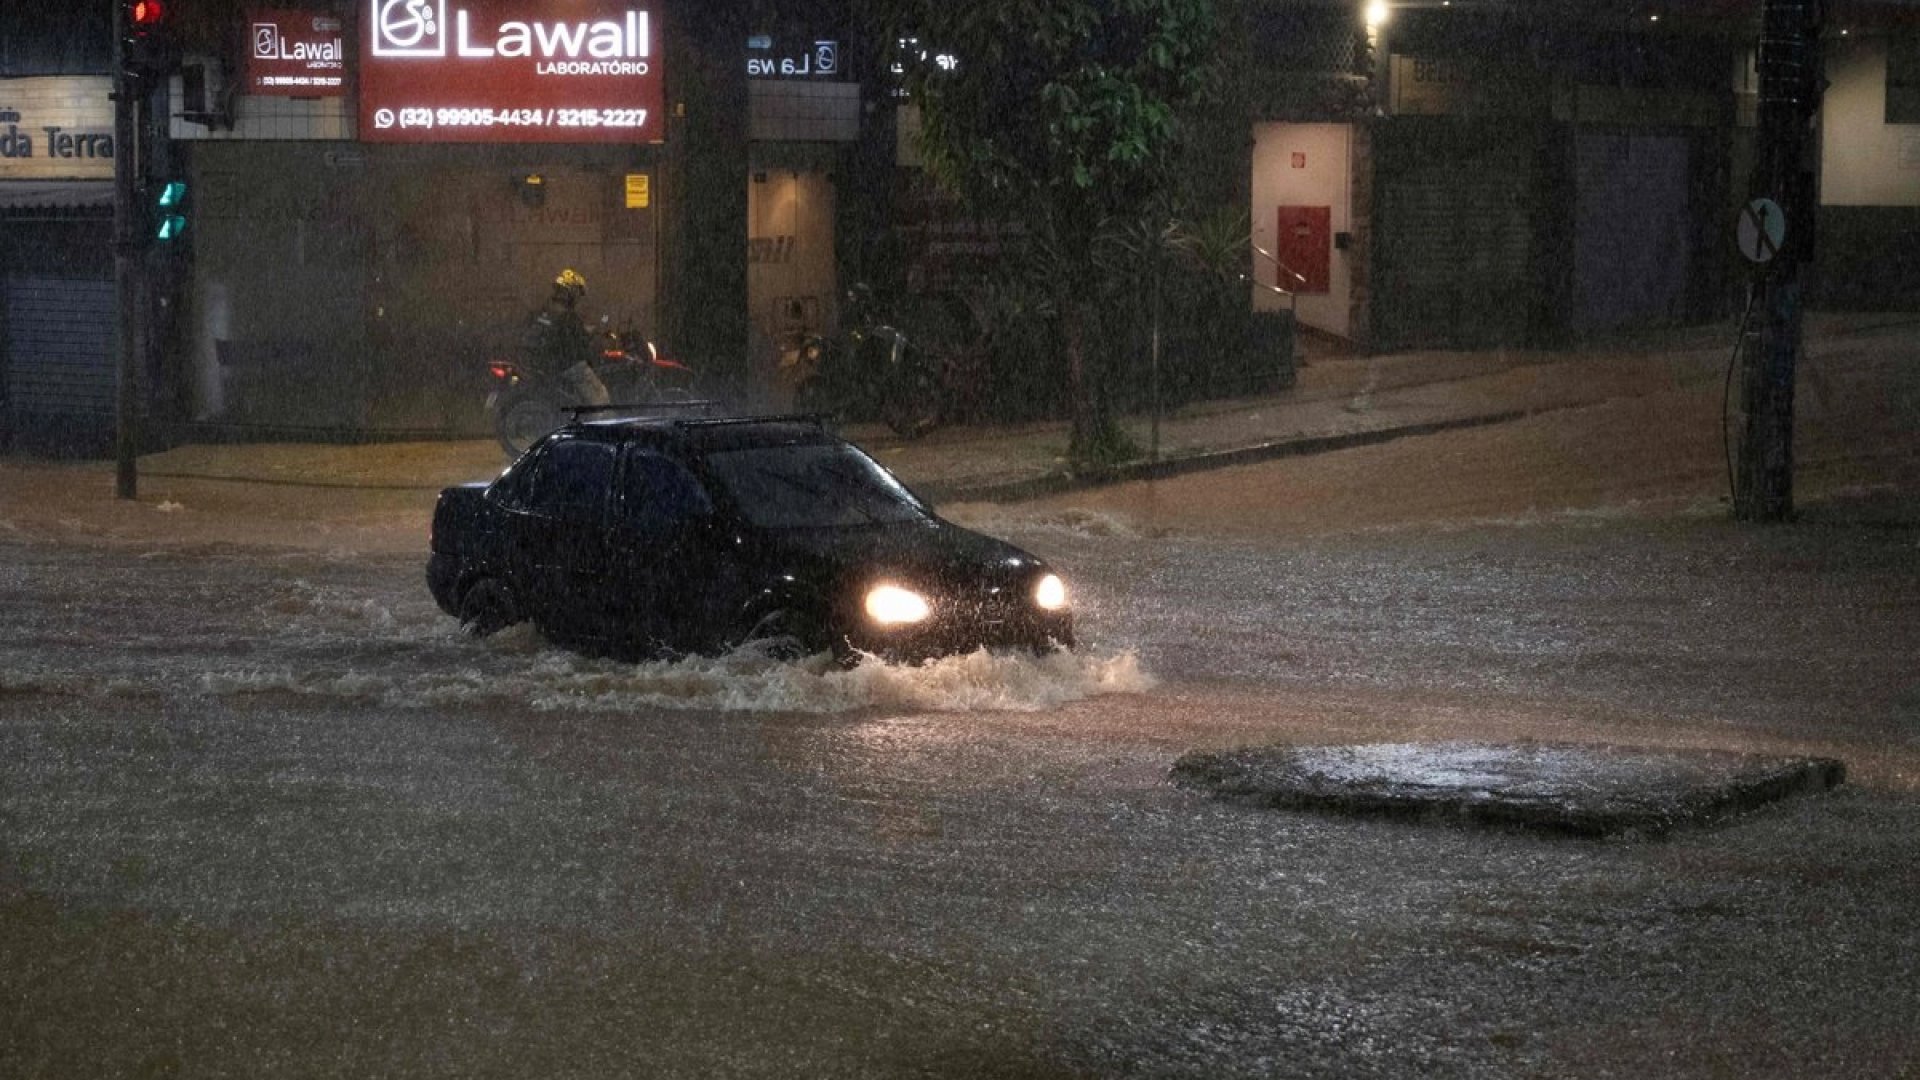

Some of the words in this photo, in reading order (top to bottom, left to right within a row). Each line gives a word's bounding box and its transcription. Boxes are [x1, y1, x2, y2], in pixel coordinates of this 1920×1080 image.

[458, 10, 648, 57] Lawall
[281, 36, 342, 60] Lawall
[537, 60, 648, 75] LABORATÓRIO
[399, 108, 433, 128] (32)
[437, 108, 542, 127] 99905-4434
[546, 109, 554, 127] /
[557, 109, 647, 127] 3215-2227
[0, 125, 32, 158] da
[43, 126, 114, 158] Terra
